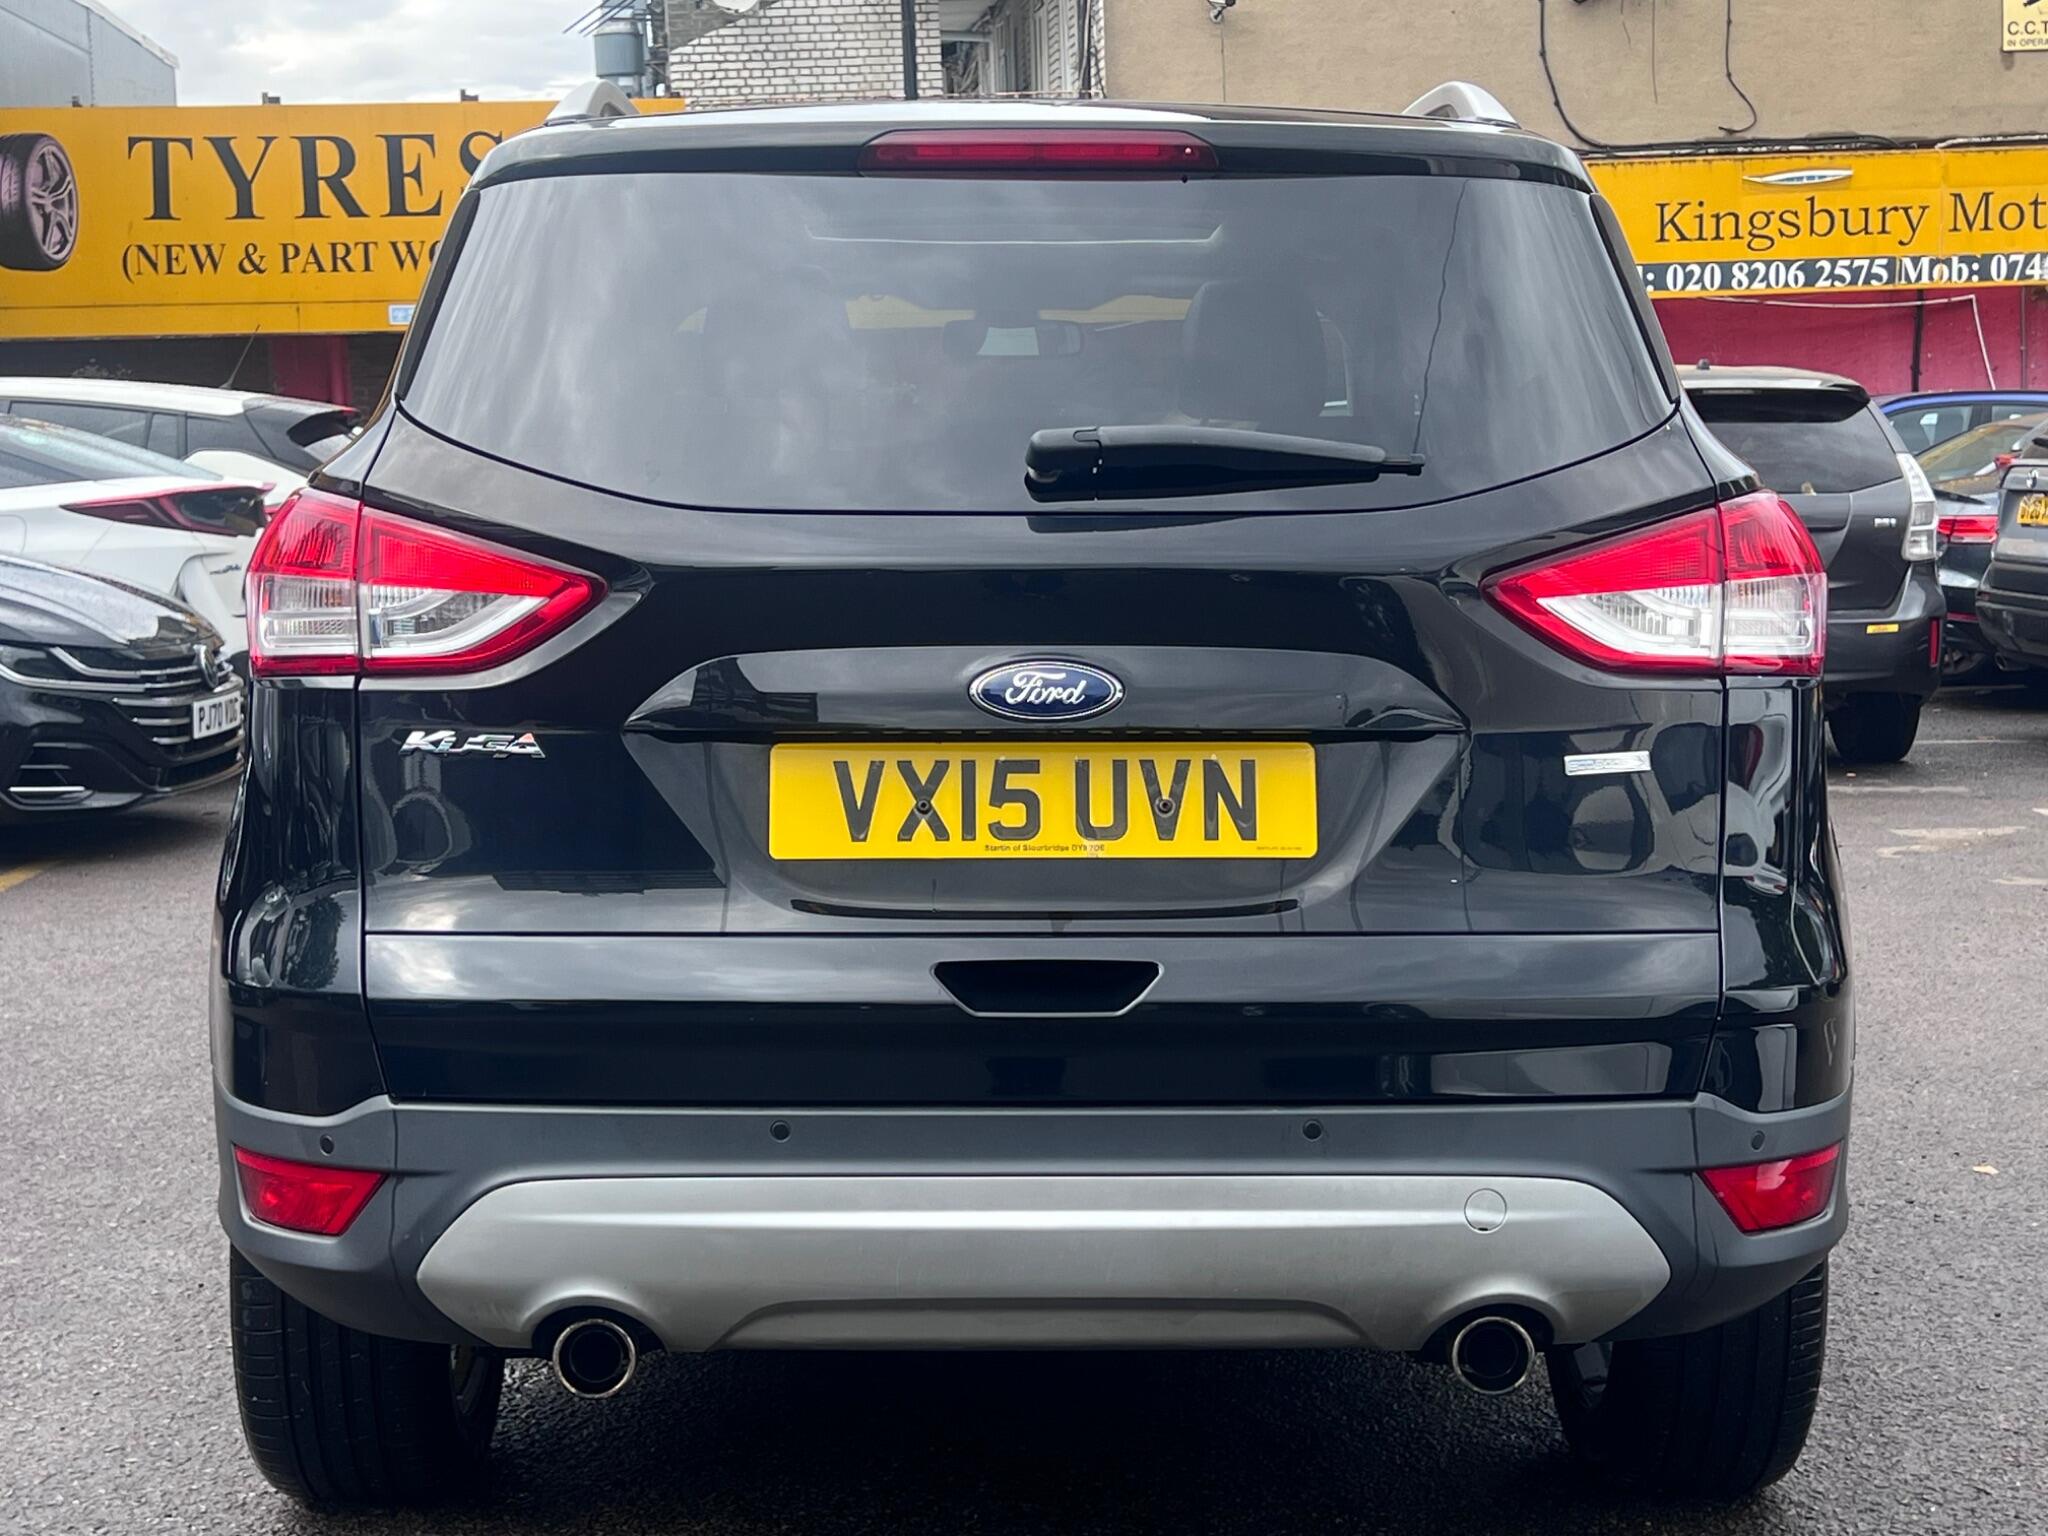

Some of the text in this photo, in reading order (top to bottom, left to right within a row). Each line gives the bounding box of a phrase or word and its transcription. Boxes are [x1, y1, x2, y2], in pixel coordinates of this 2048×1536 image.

[1655, 190, 2048, 252] Kingsbury Mot
[122, 242, 227, 285] (NEW
[238, 242, 268, 276] &
[279, 240, 379, 275] PART
[1666, 263, 1723, 292] 020
[1731, 260, 1806, 291] 8206
[1814, 257, 1890, 289] 2575
[1899, 255, 1980, 286] Mob:
[1004, 670, 1087, 705] Ford
[833, 758, 1258, 843] VX15 UVN
